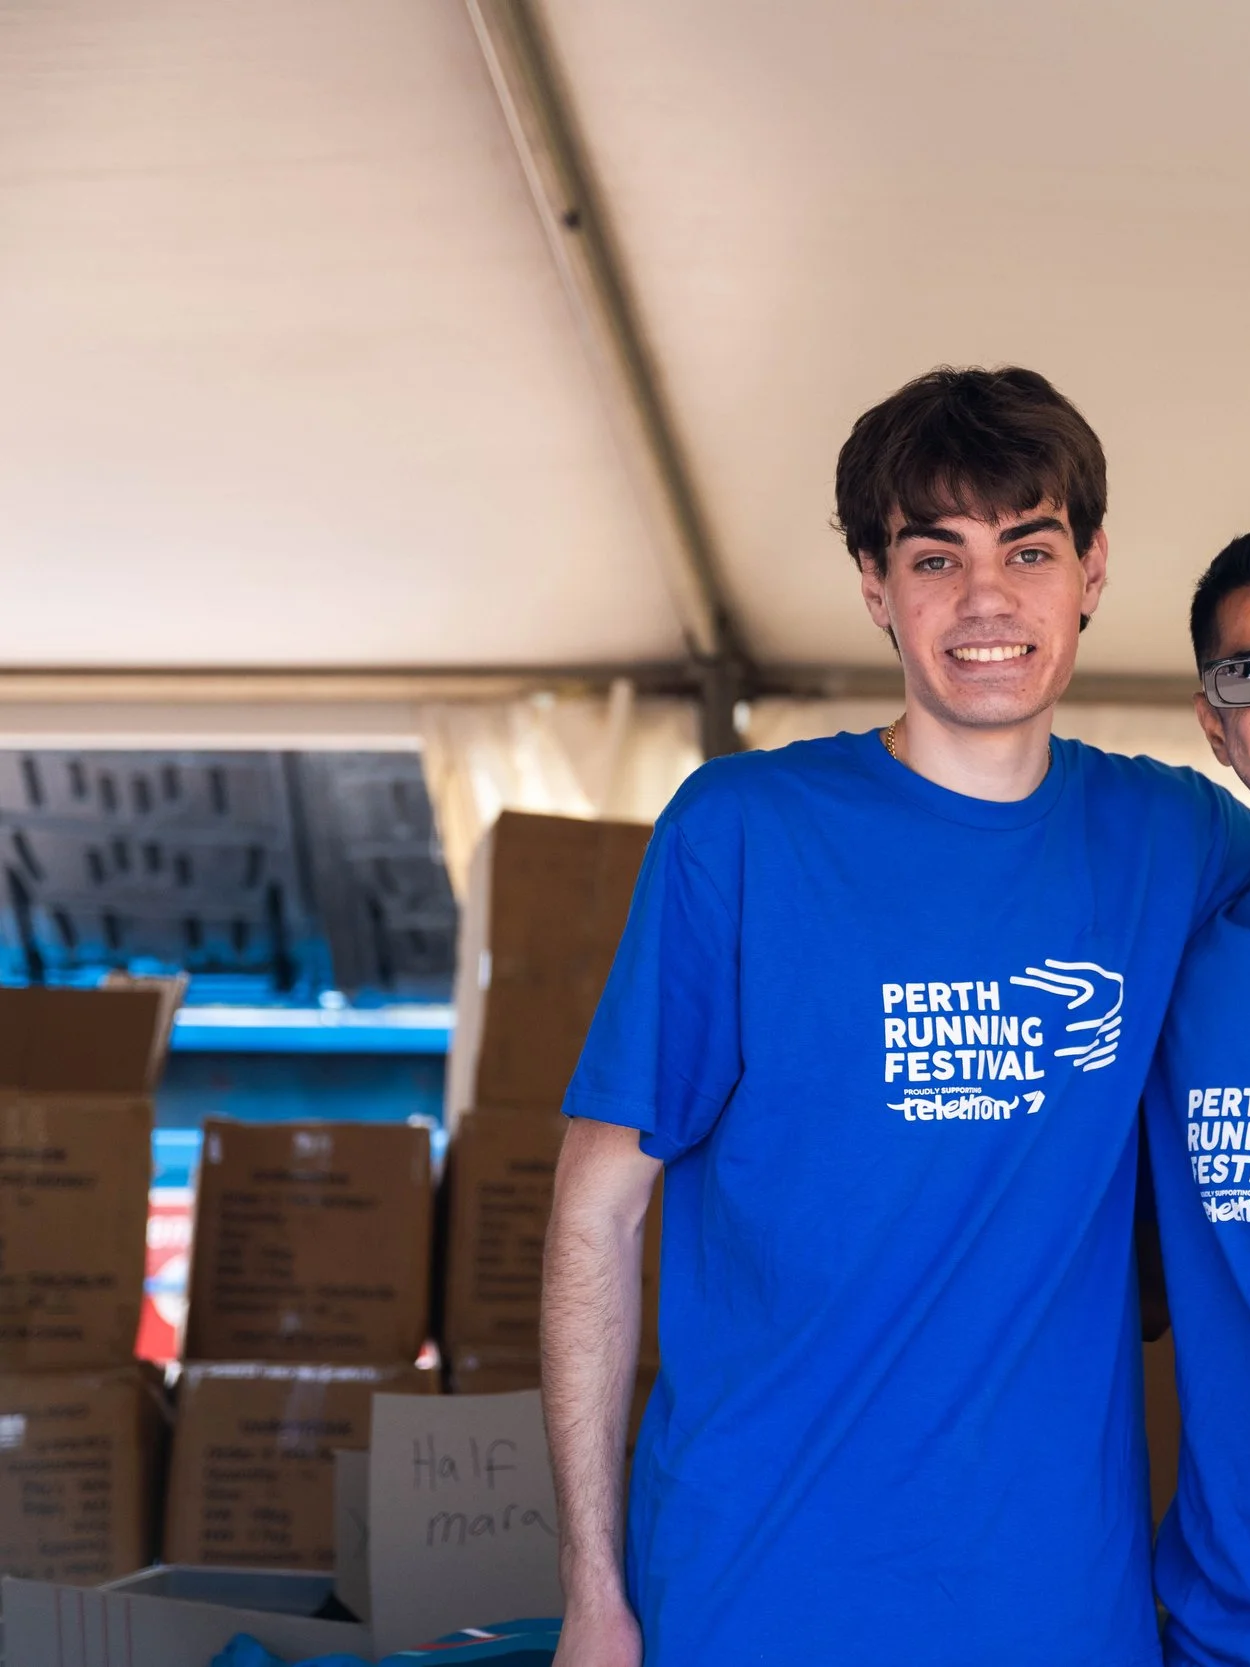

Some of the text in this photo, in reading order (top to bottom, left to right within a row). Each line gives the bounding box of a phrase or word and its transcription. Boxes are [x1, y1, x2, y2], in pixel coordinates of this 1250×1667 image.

[883, 981, 1001, 1014] PERTH
[884, 1015, 1043, 1048] RUNNING
[884, 1050, 1045, 1083] FESTIVAL
[904, 1086, 982, 1096] PROUDLY SUPPORTING
[412, 1432, 518, 1491] Half
[426, 1502, 557, 1547] mara
